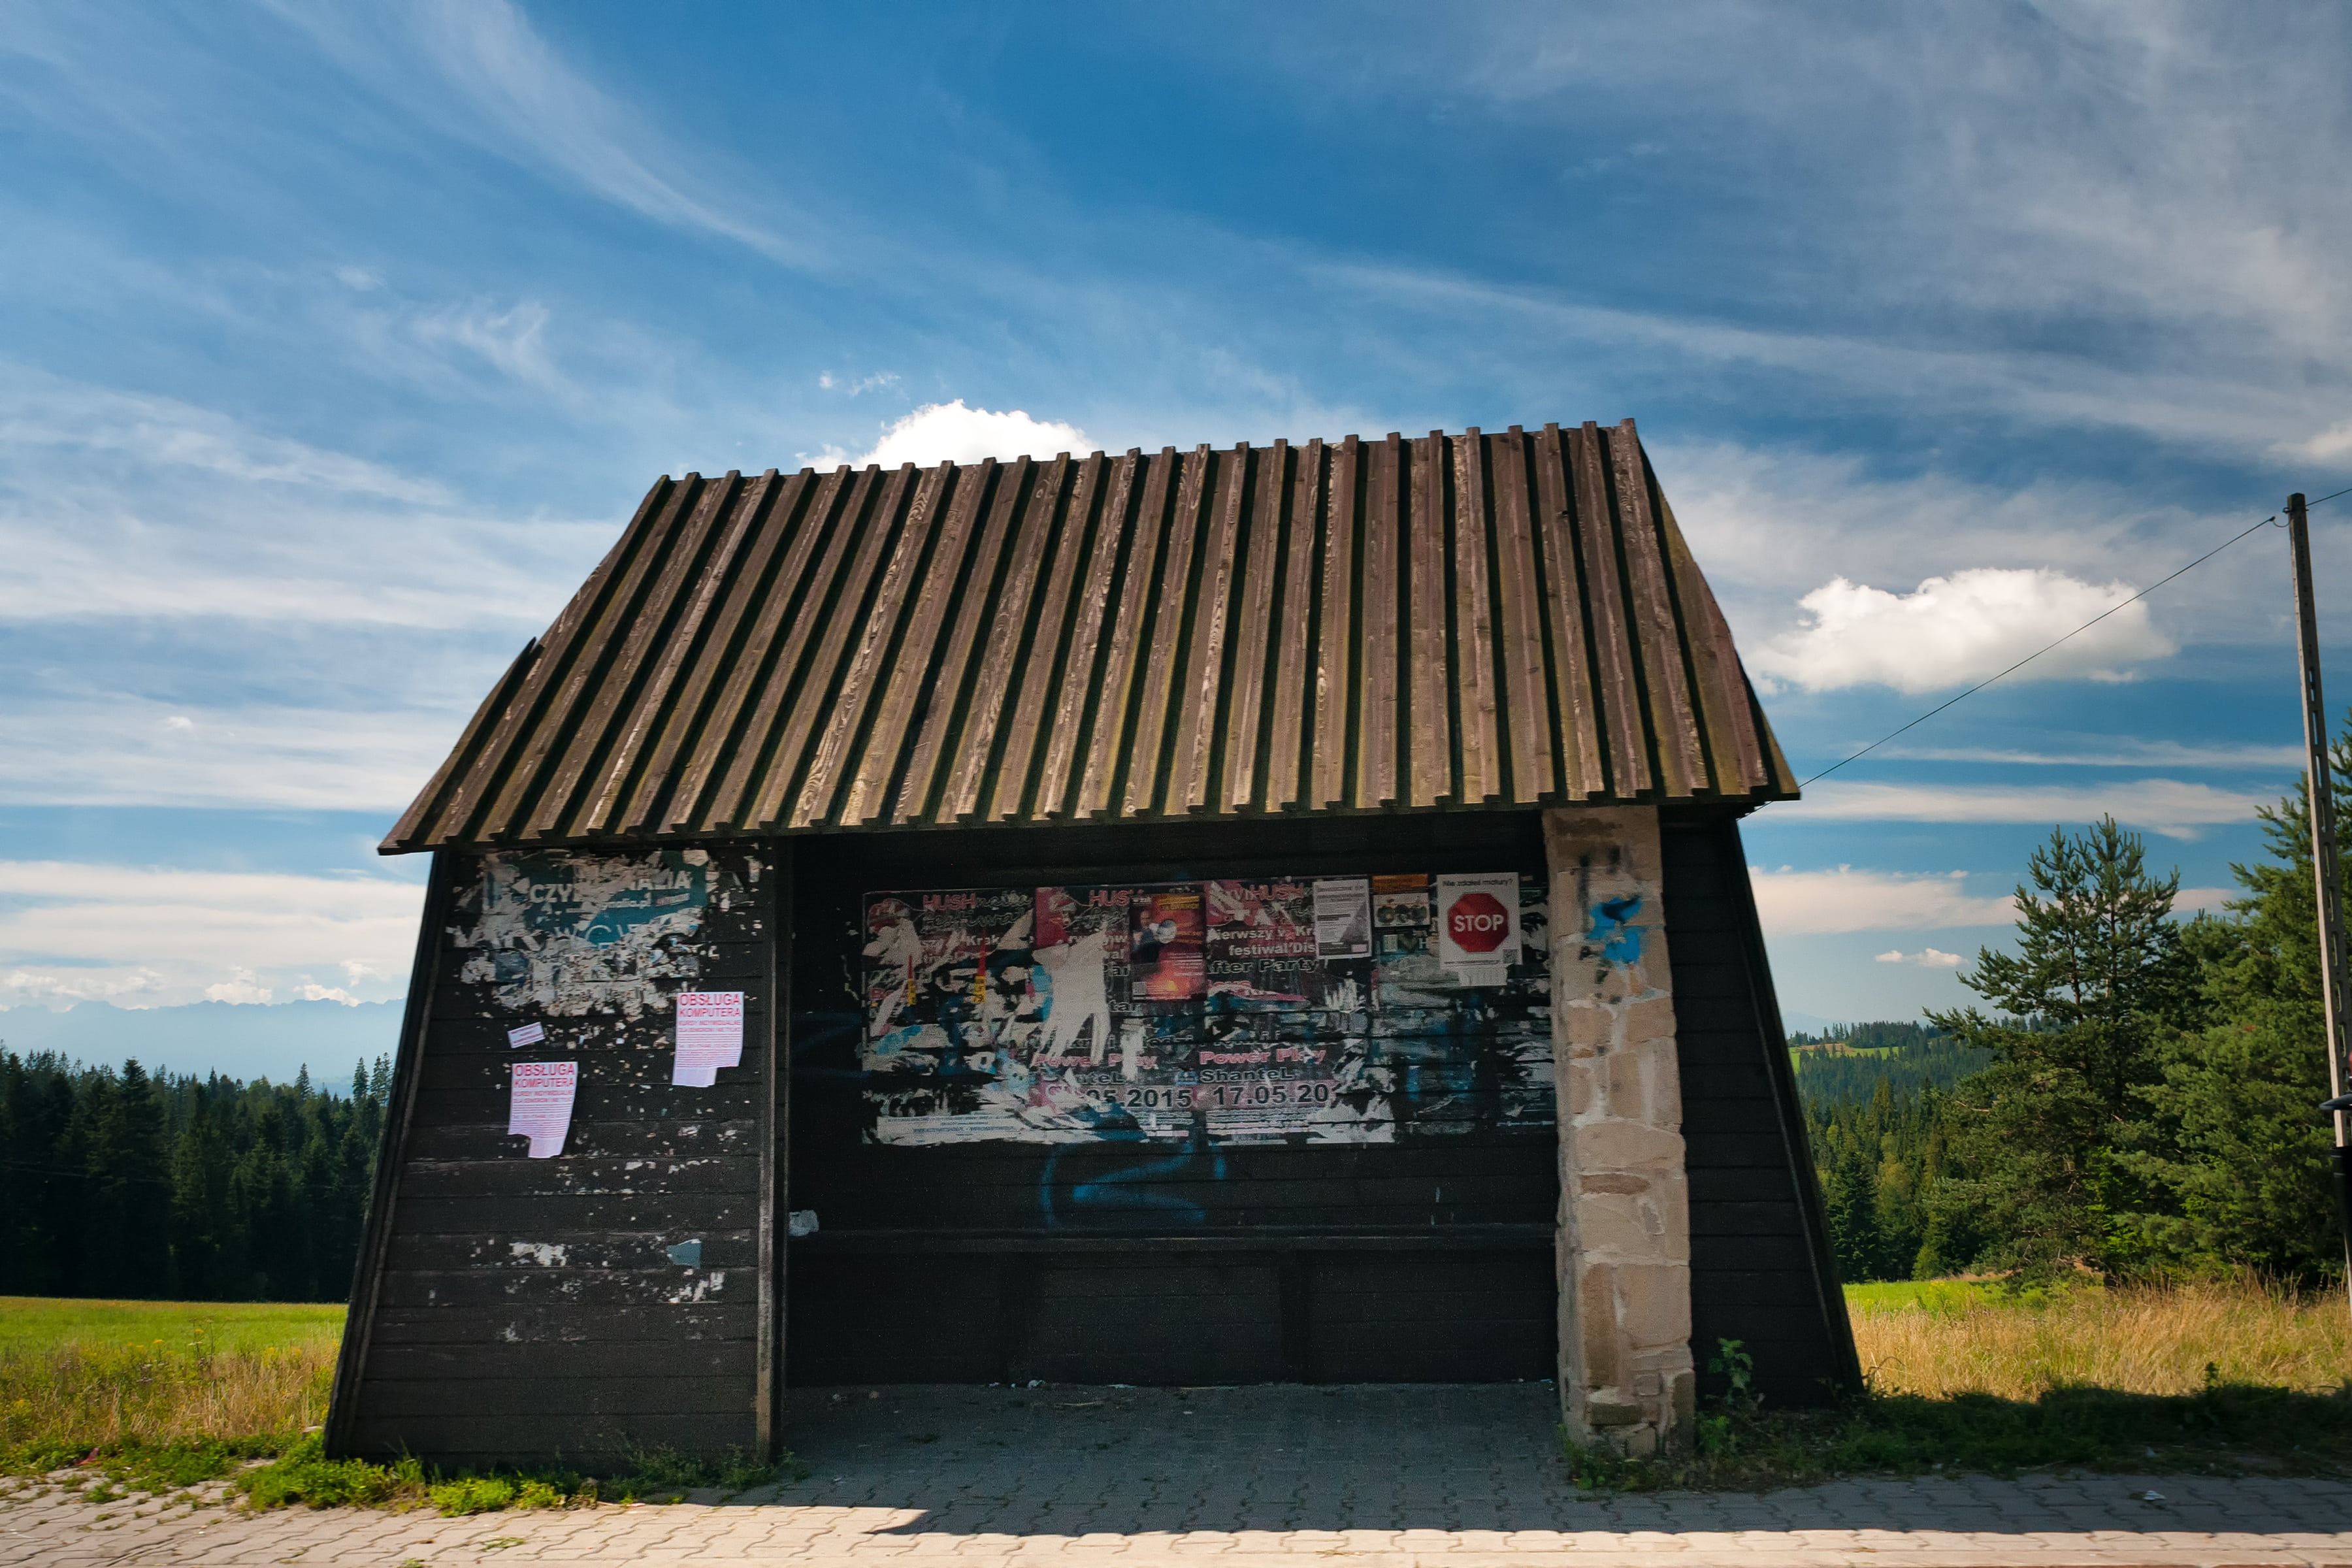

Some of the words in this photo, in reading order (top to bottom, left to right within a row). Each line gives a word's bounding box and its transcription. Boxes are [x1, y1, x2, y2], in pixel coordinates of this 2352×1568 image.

[1088, 889, 1134, 907] HUS
[1249, 883, 1305, 900] HUSH
[923, 893, 976, 911] HUSH
[1454, 914, 1504, 932] STOP
[966, 935, 1000, 945] Krak
[1216, 929, 1273, 941] ierwszy
[1229, 943, 1288, 956] festiwal
[1293, 942, 1315, 953] Dis
[1259, 958, 1317, 973] Party
[679, 994, 741, 1005] OBSŁUGA
[679, 1008, 742, 1017] KOMPUTERA
[1033, 1053, 1096, 1068] Powe
[1108, 1053, 1159, 1069] Pay
[1199, 1050, 1271, 1065] Power
[515, 1064, 575, 1076] OBSŁUGA
[1200, 1068, 1295, 1083] ShanteL
[514, 1077, 575, 1088] KOMPUTERA
[1213, 1083, 1330, 1106] 17.05.20
